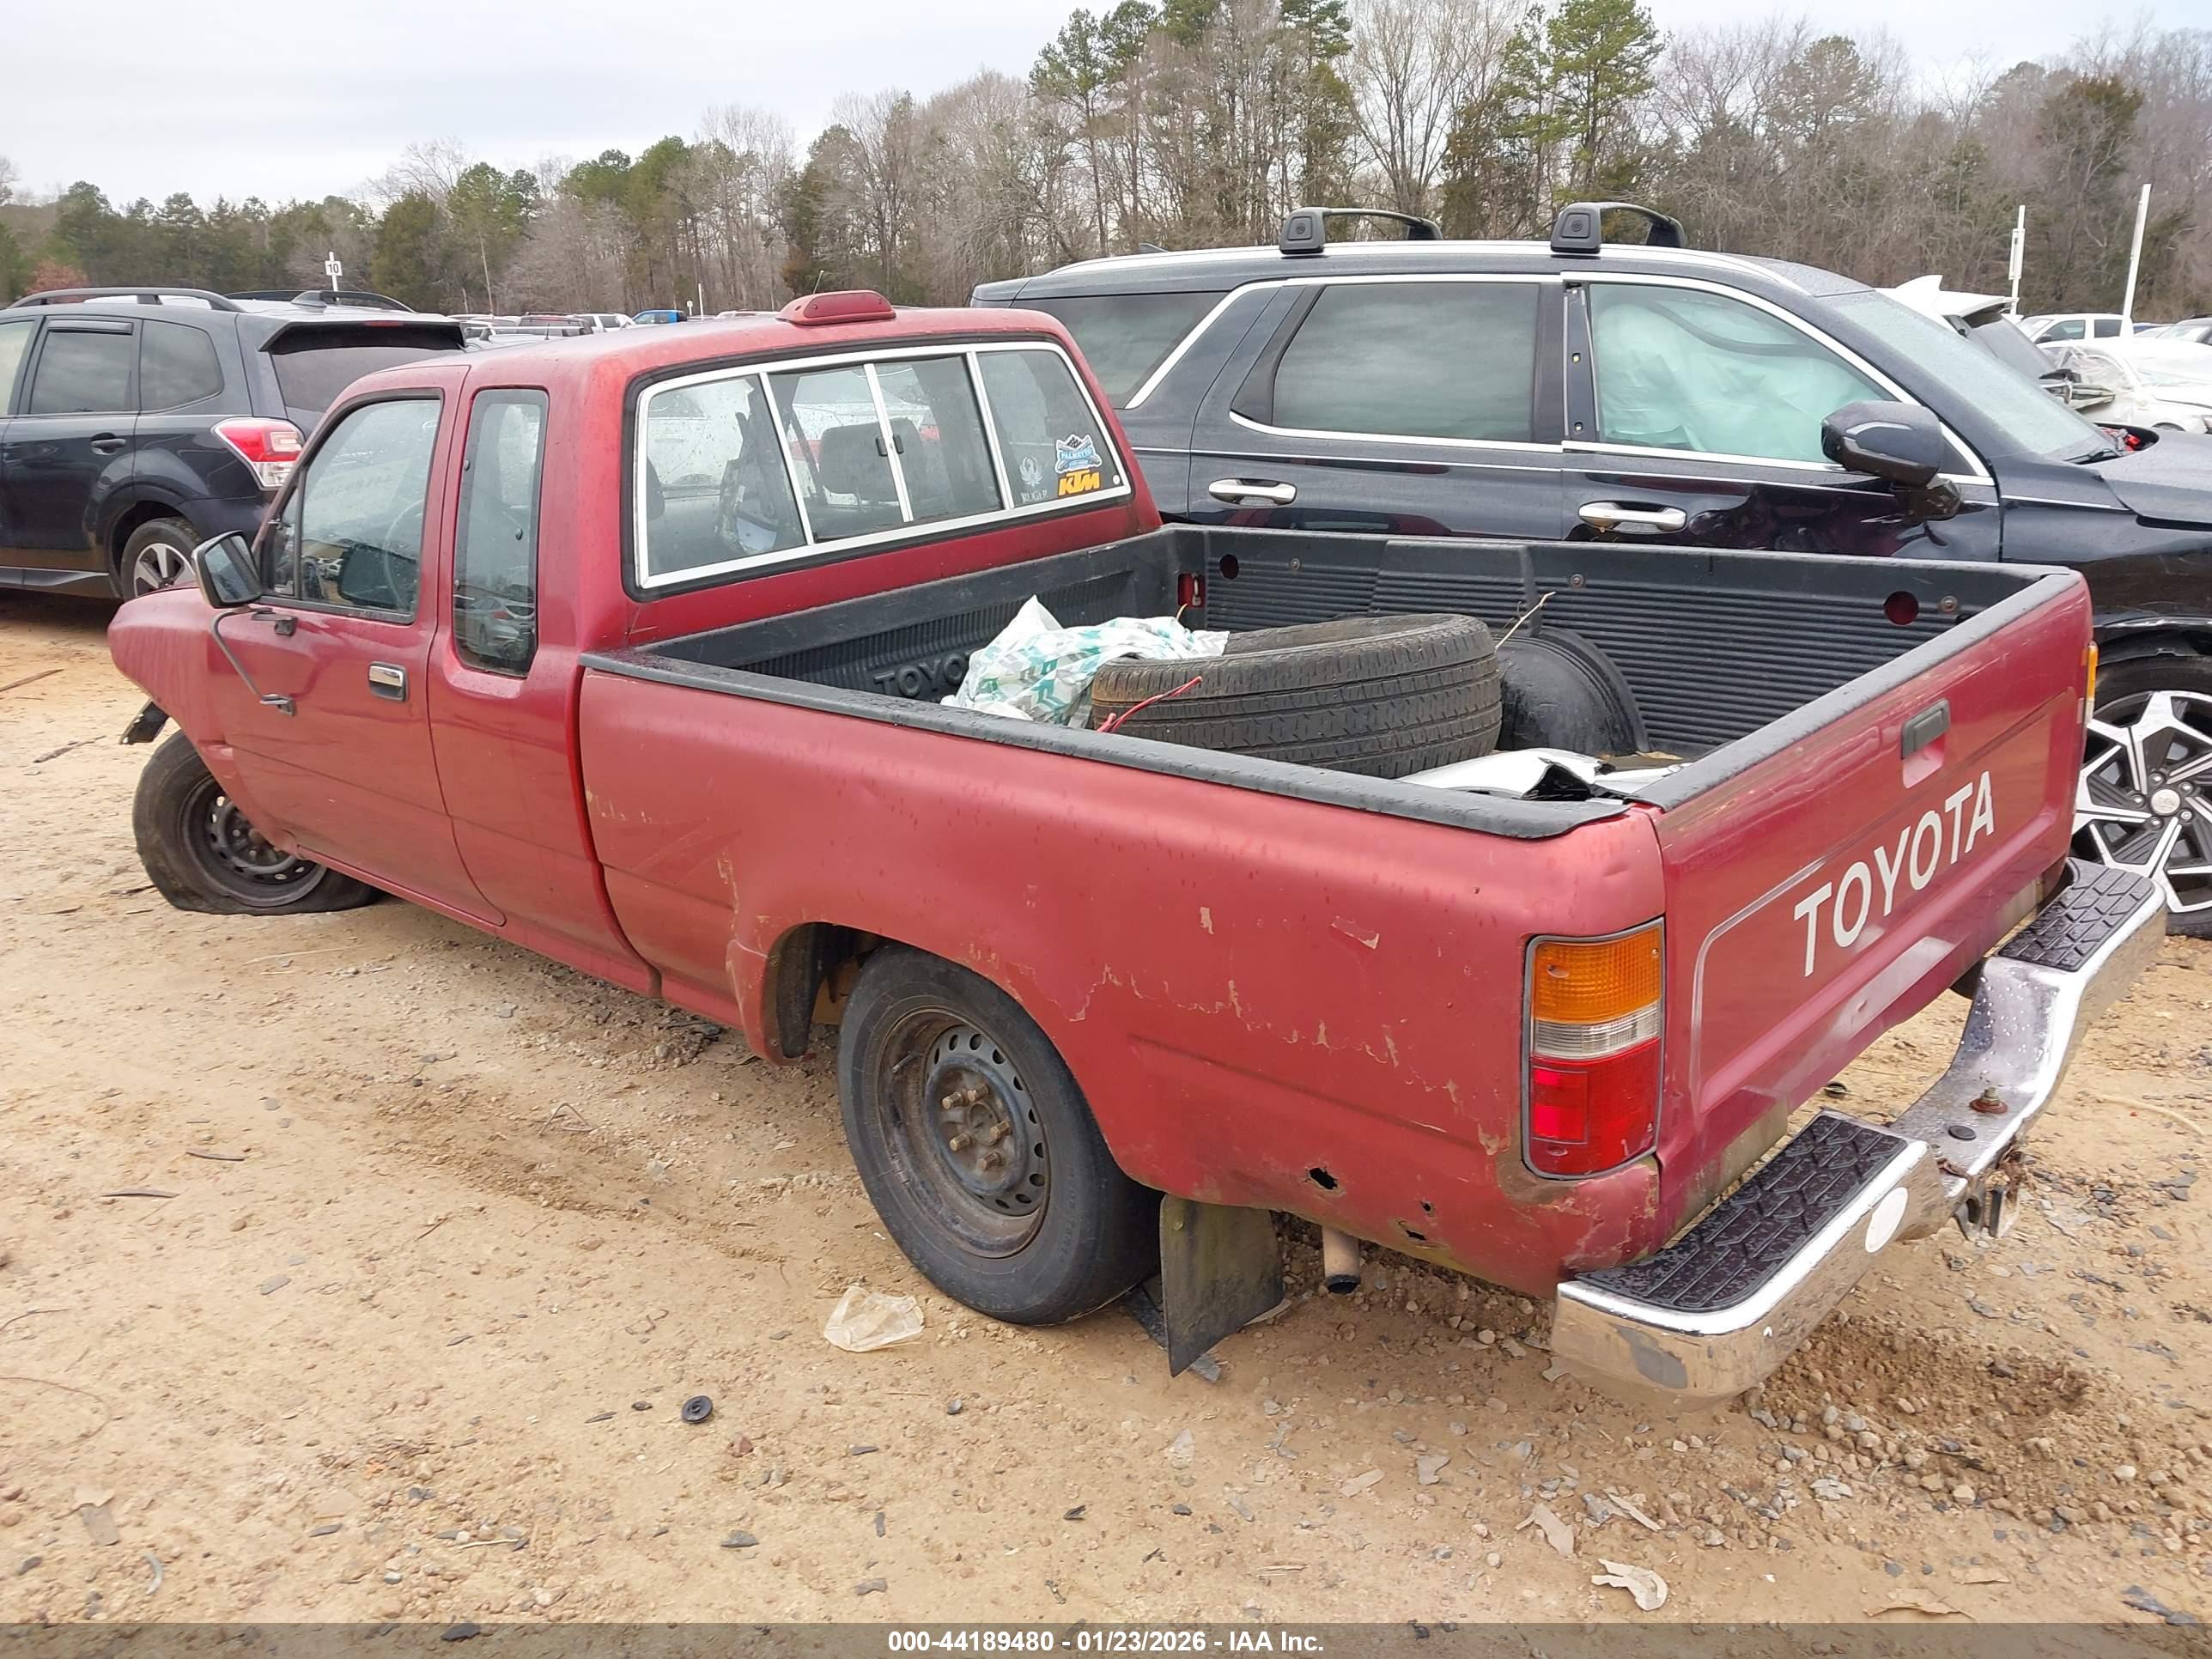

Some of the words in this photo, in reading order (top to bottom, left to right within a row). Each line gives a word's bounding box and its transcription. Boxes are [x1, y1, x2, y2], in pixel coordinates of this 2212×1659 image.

[327, 264, 339, 273] 10
[1059, 471, 1100, 495] KTM
[874, 650, 969, 696] TOYO
[1794, 770, 1994, 977] TOYOTA
